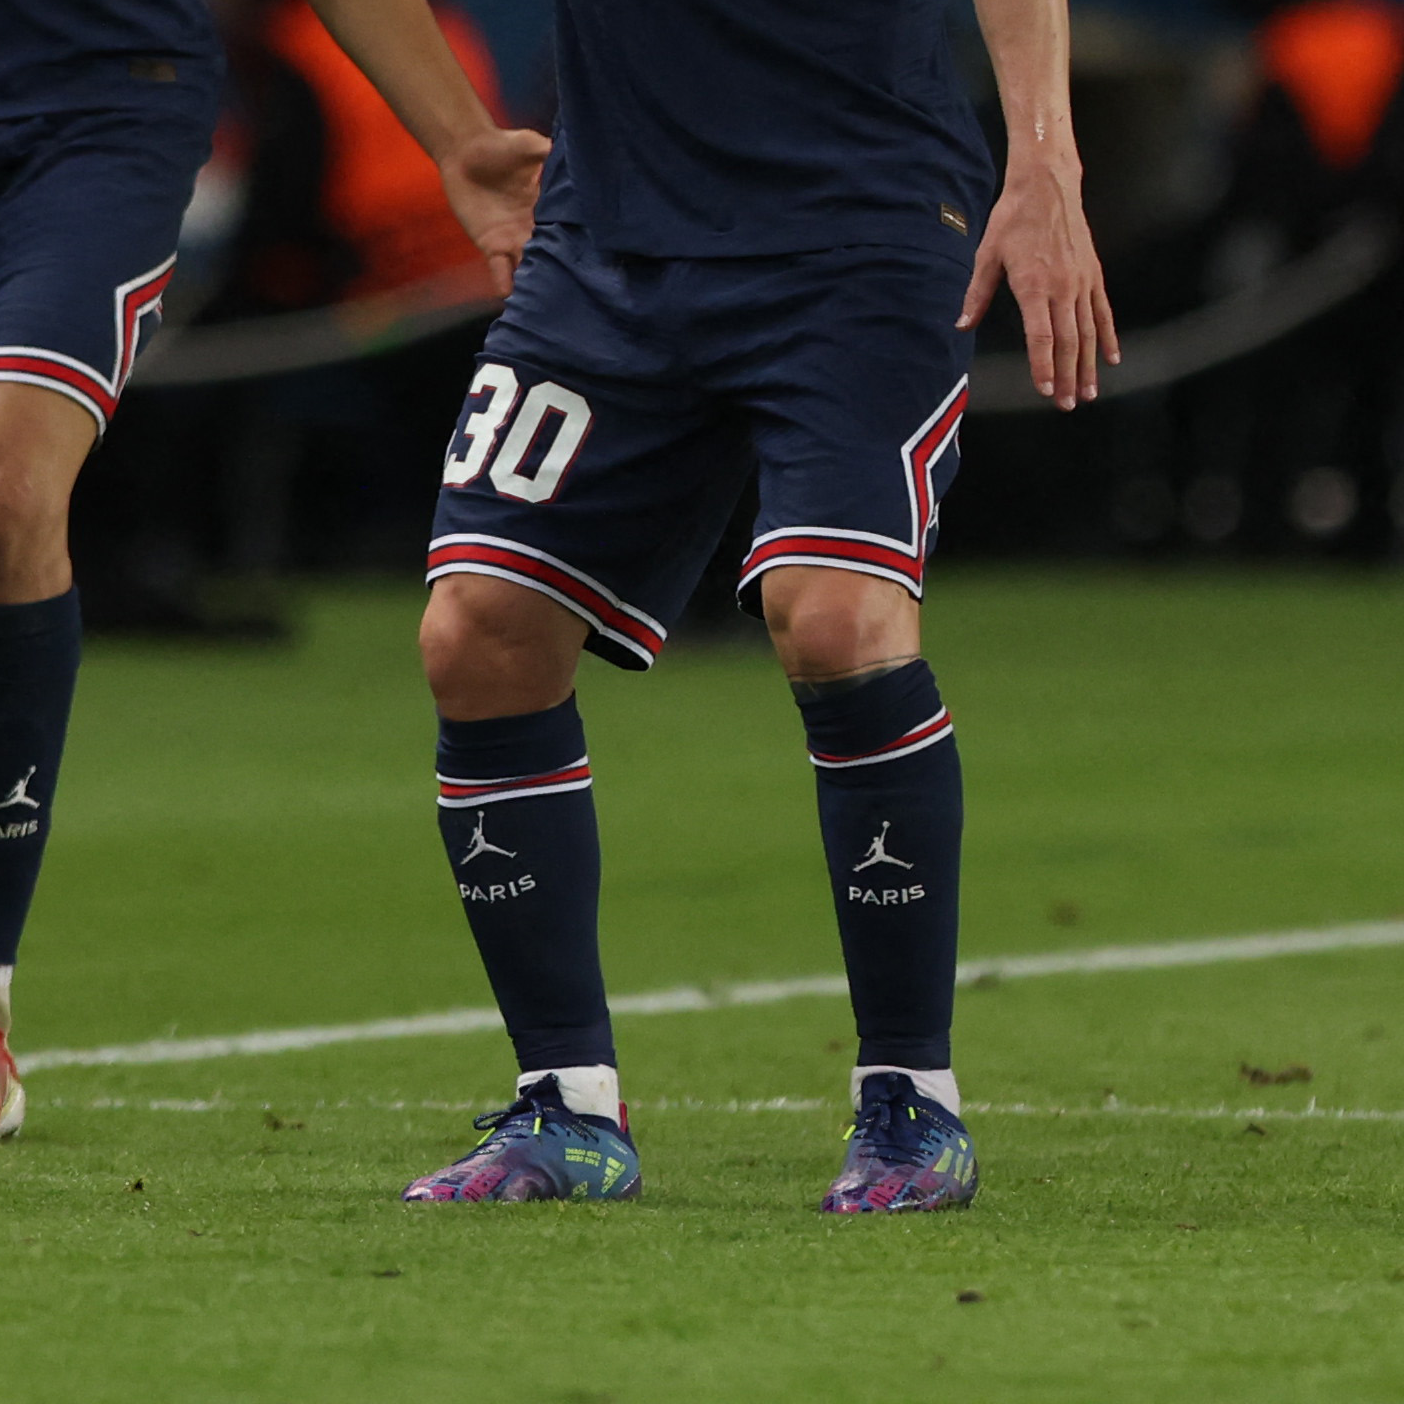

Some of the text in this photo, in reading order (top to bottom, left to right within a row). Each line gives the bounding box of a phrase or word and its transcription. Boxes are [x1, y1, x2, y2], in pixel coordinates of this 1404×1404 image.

[443, 362, 596, 505] 30
[459, 874, 537, 904] PARIS
[848, 884, 926, 906] PARIS
